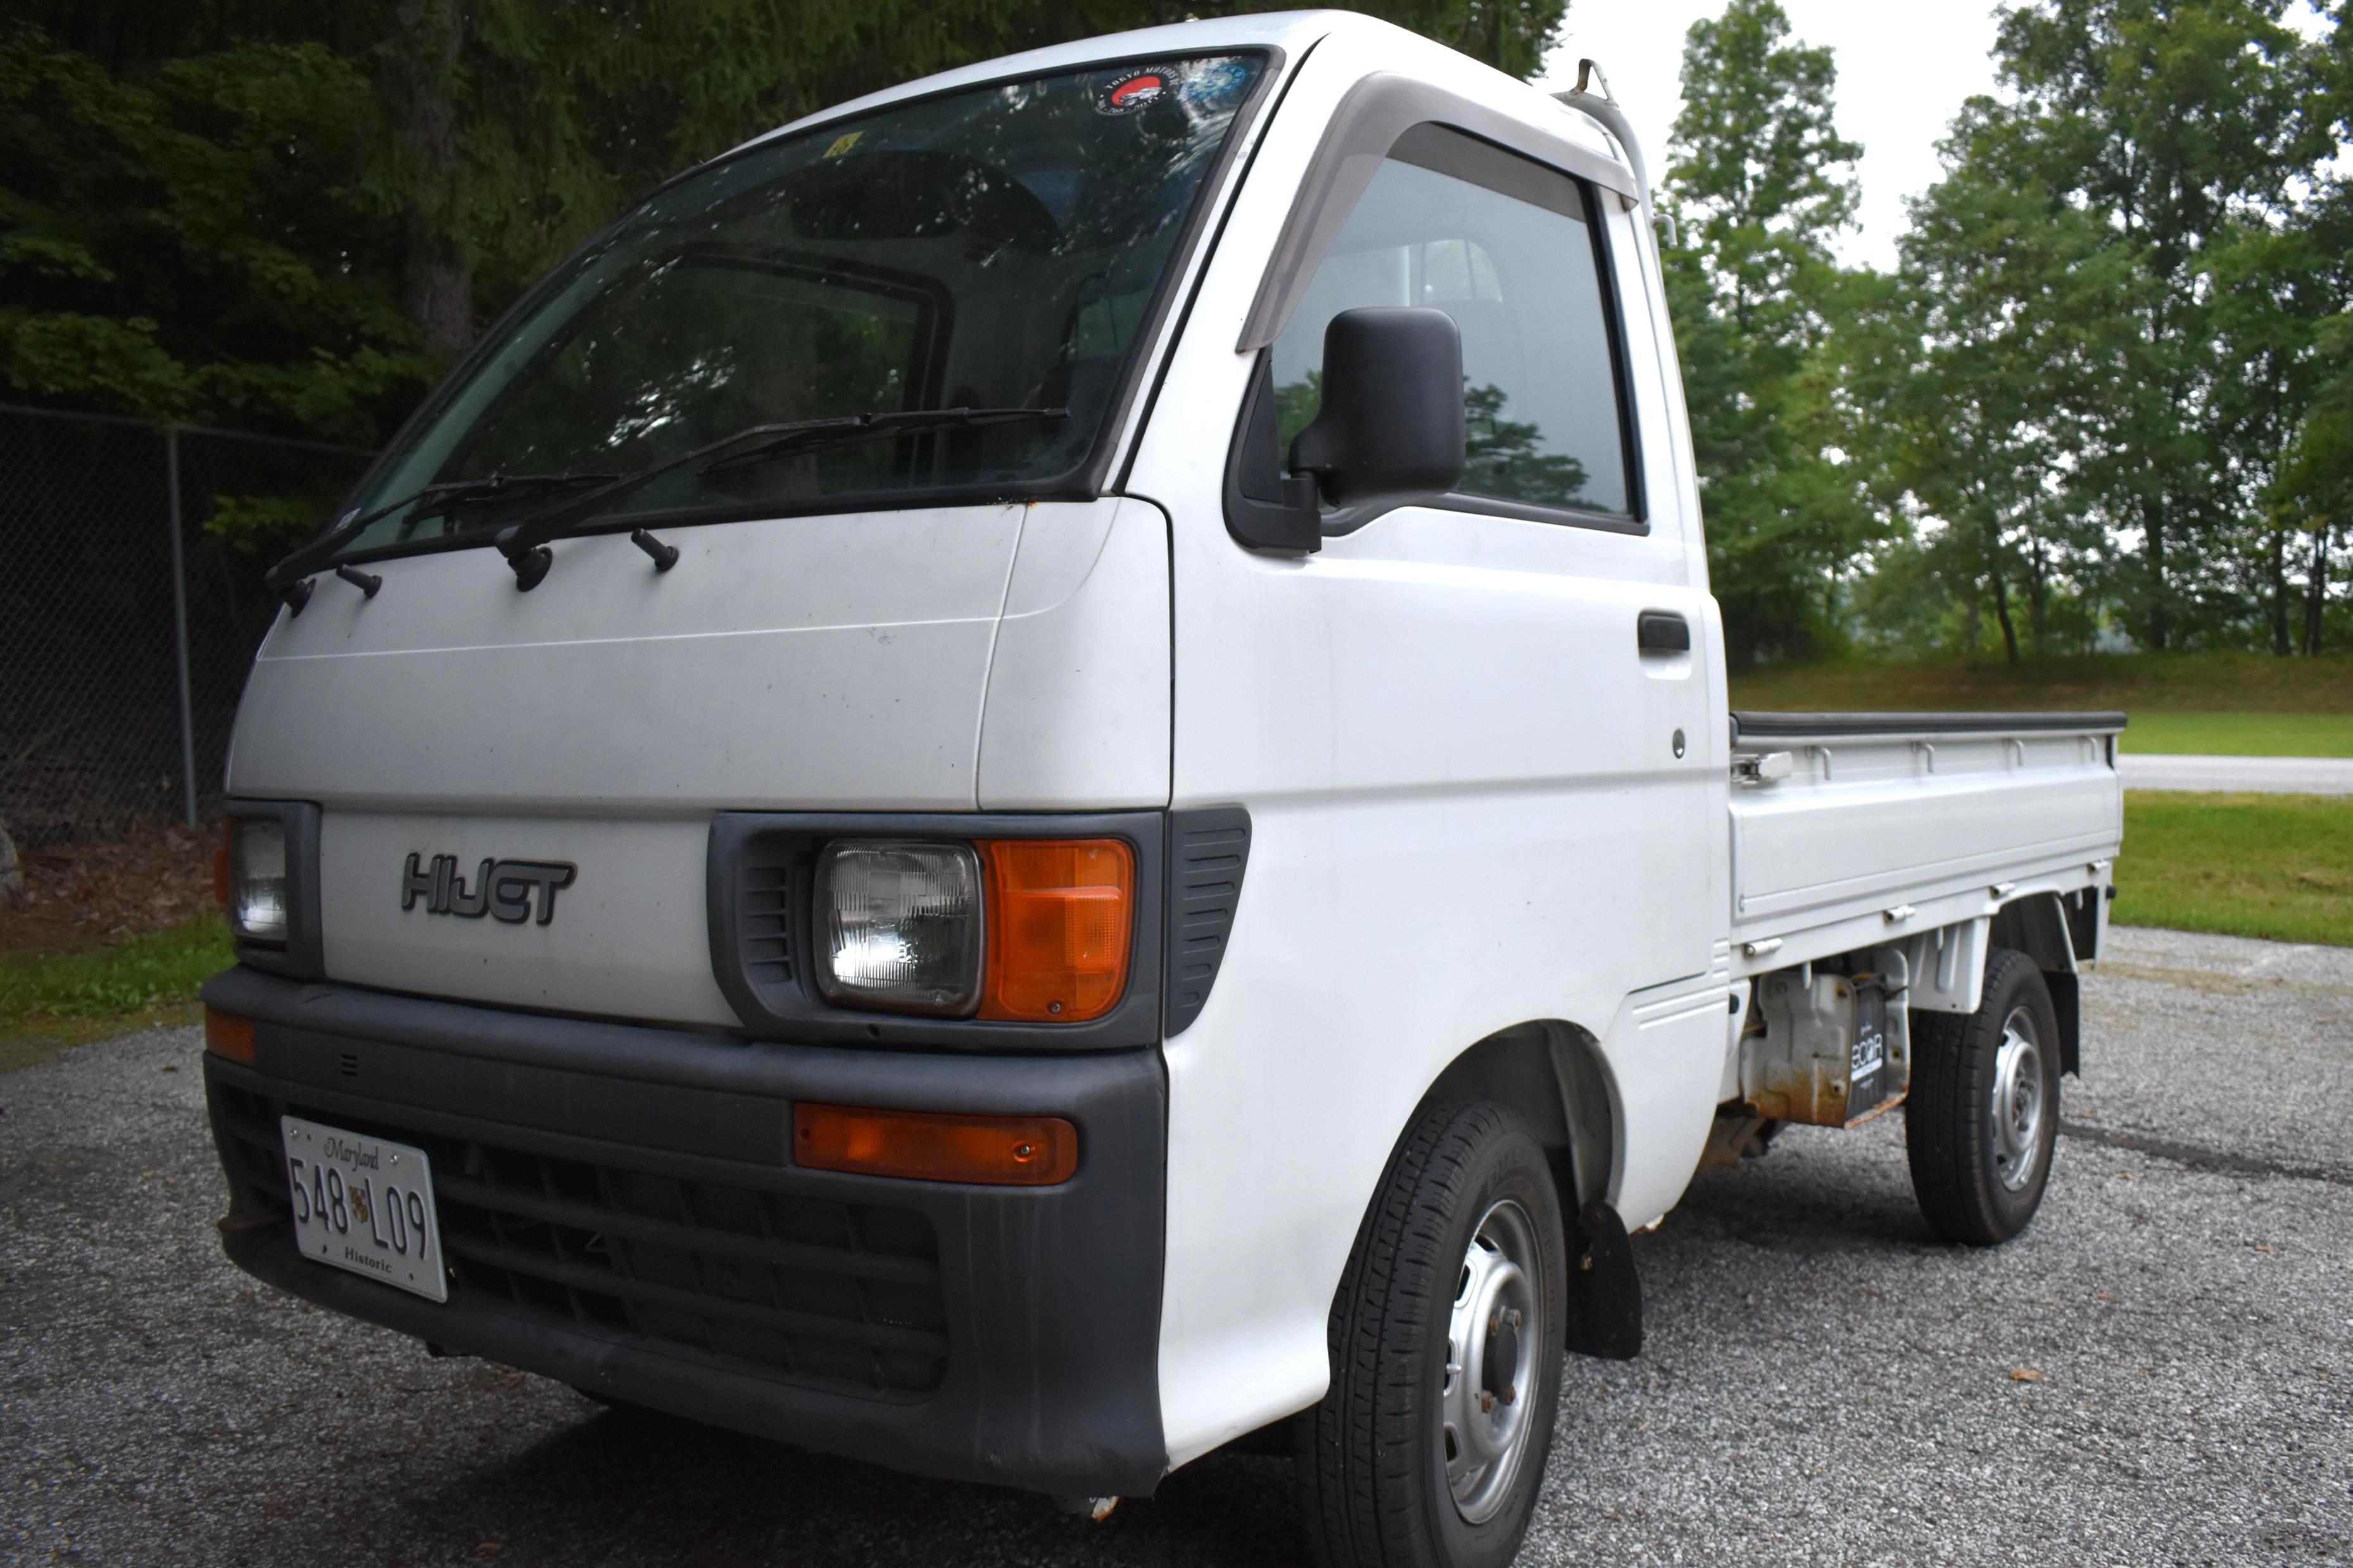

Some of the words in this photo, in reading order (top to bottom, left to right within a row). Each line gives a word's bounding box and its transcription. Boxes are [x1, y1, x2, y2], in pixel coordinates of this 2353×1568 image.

[1104, 70, 1140, 89] TOKYO
[401, 852, 577, 926] HIJET
[324, 1137, 379, 1171] Maryland
[290, 1157, 349, 1234] 548
[365, 1177, 427, 1261] L09
[344, 1246, 392, 1273] Historic
